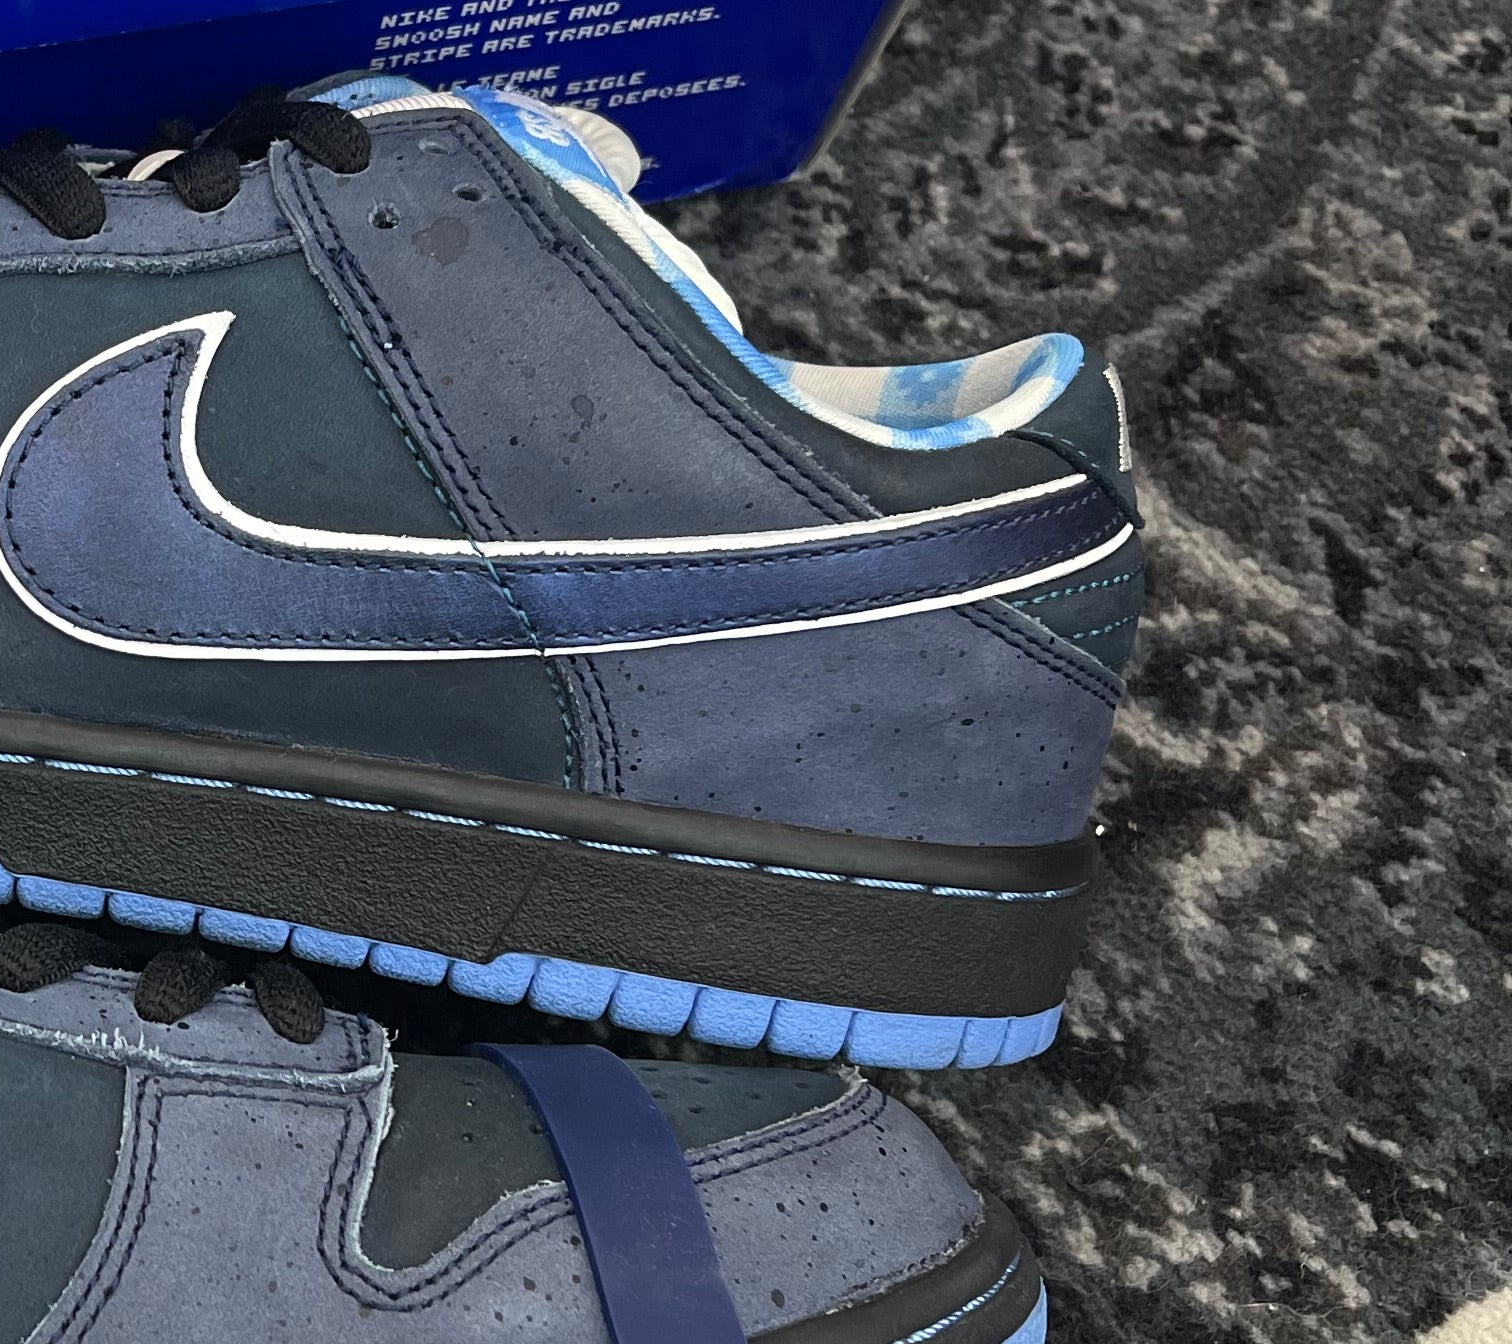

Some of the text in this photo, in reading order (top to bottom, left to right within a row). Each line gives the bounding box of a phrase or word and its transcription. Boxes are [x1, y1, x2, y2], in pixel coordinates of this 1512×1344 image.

[374, 1, 620, 50] SWOOSH NAME AND
[380, 6, 452, 29] NIKE
[369, 7, 721, 71] STRIPE ARE TRADEMARKS.
[565, 71, 646, 95] SIGLE
[608, 73, 746, 108] DEPOSEES.
